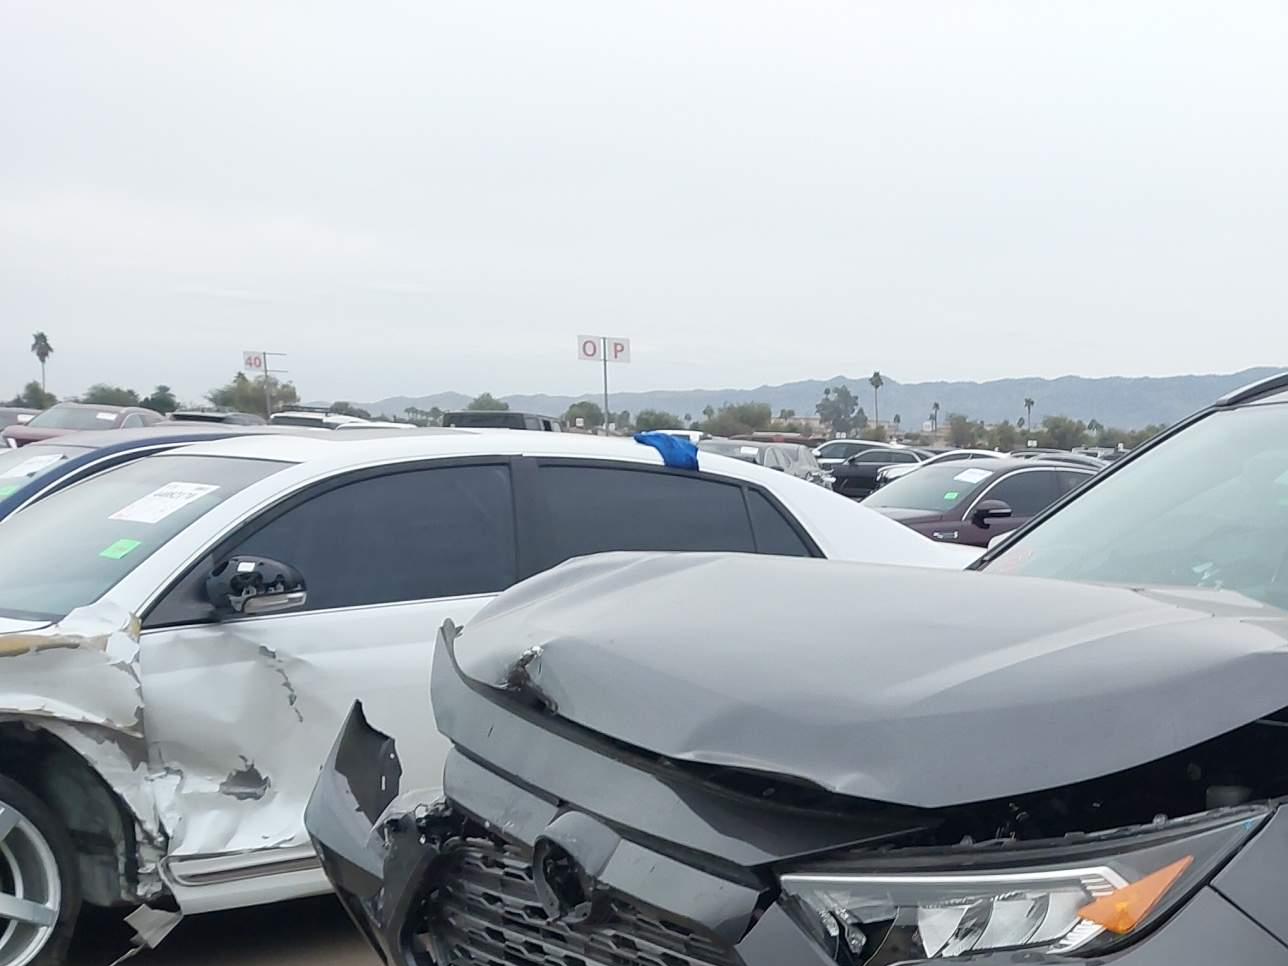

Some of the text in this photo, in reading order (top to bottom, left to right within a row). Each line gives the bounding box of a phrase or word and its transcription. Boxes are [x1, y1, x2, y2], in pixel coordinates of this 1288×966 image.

[582, 340, 596, 357] O
[614, 343, 625, 359] P
[245, 356, 262, 368] 40
